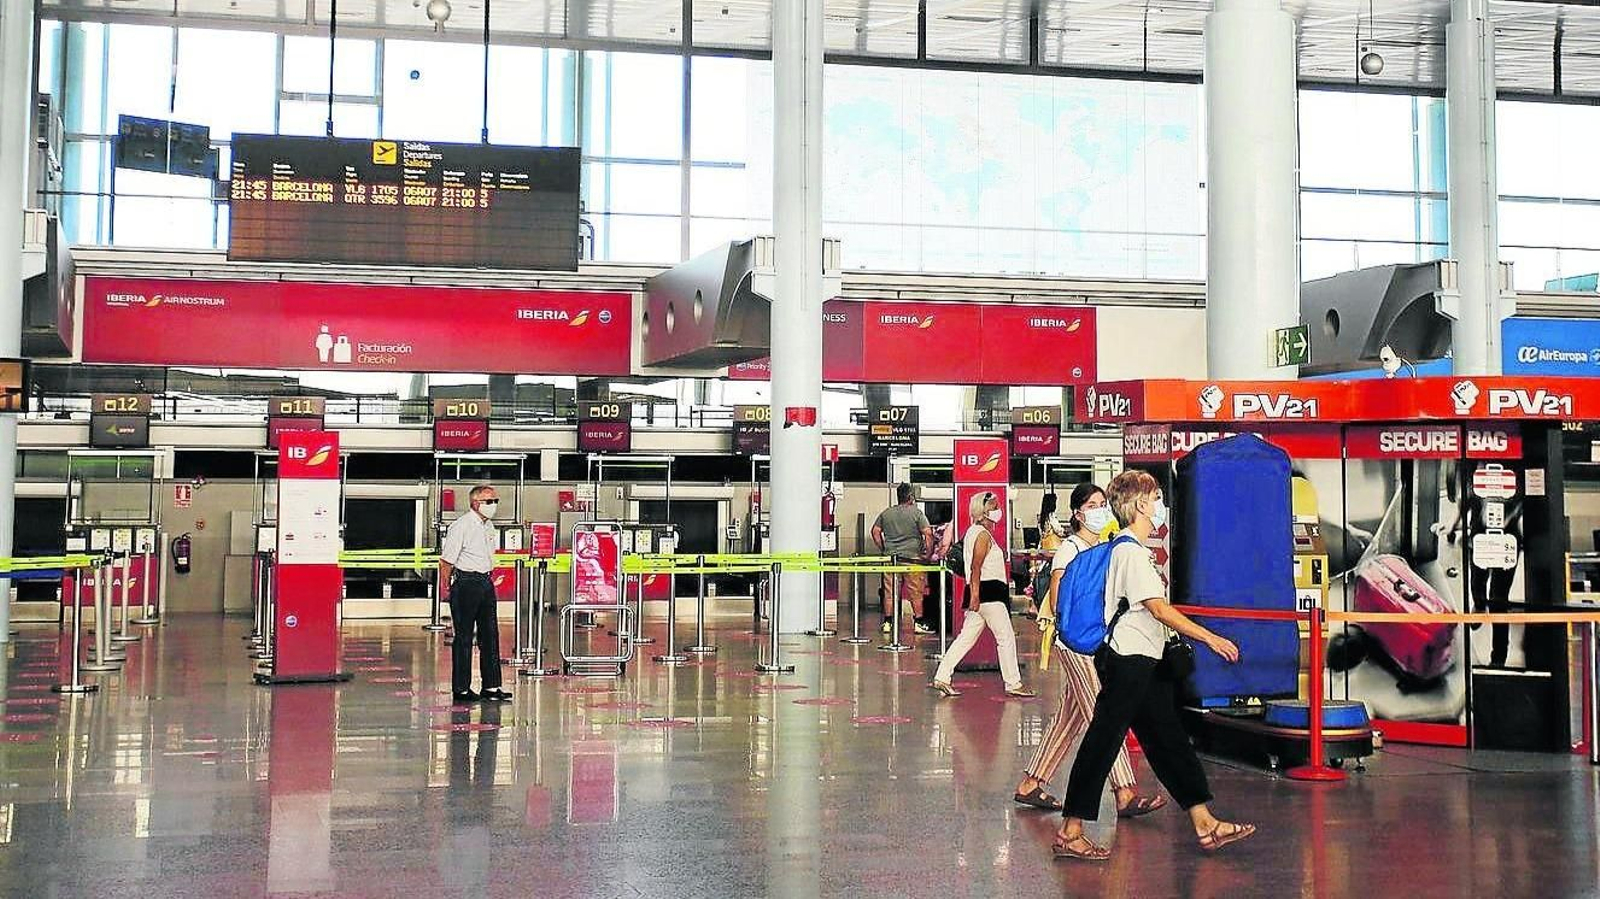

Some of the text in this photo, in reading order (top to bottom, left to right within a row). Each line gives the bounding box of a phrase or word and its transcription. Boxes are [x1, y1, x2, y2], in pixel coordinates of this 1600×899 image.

[403, 150, 443, 160] Departures
[231, 180, 267, 190] 21:45
[272, 181, 334, 193] BARCELONA
[441, 188, 476, 198] 21:00
[231, 190, 267, 200] 21:45
[272, 191, 334, 202] BARCELONA
[441, 198, 476, 207] 21:00
[106, 294, 146, 303] IBERIA
[517, 309, 569, 320] IBERIA
[880, 315, 919, 325] IBERIA
[1030, 318, 1067, 329] IBERIA
[357, 343, 412, 353] Facturación
[357, 354, 396, 364] Check-in
[1538, 348, 1588, 363] AirEuropa
[117, 397, 138, 411] 12
[292, 400, 313, 413] 11
[1099, 394, 1131, 417] PV21
[1233, 393, 1319, 418] PV21
[1489, 389, 1573, 415] PV21
[459, 403, 478, 417] 10
[600, 404, 620, 418] 09
[755, 407, 771, 421] 08
[890, 407, 907, 421] 07
[1033, 410, 1051, 423] 06
[441, 430, 470, 438] IBERIA
[1379, 430, 1508, 452] SECURE BAG
[1124, 434, 1168, 455] SECURE BAG
[287, 446, 307, 459] IB
[961, 455, 978, 466] IB
